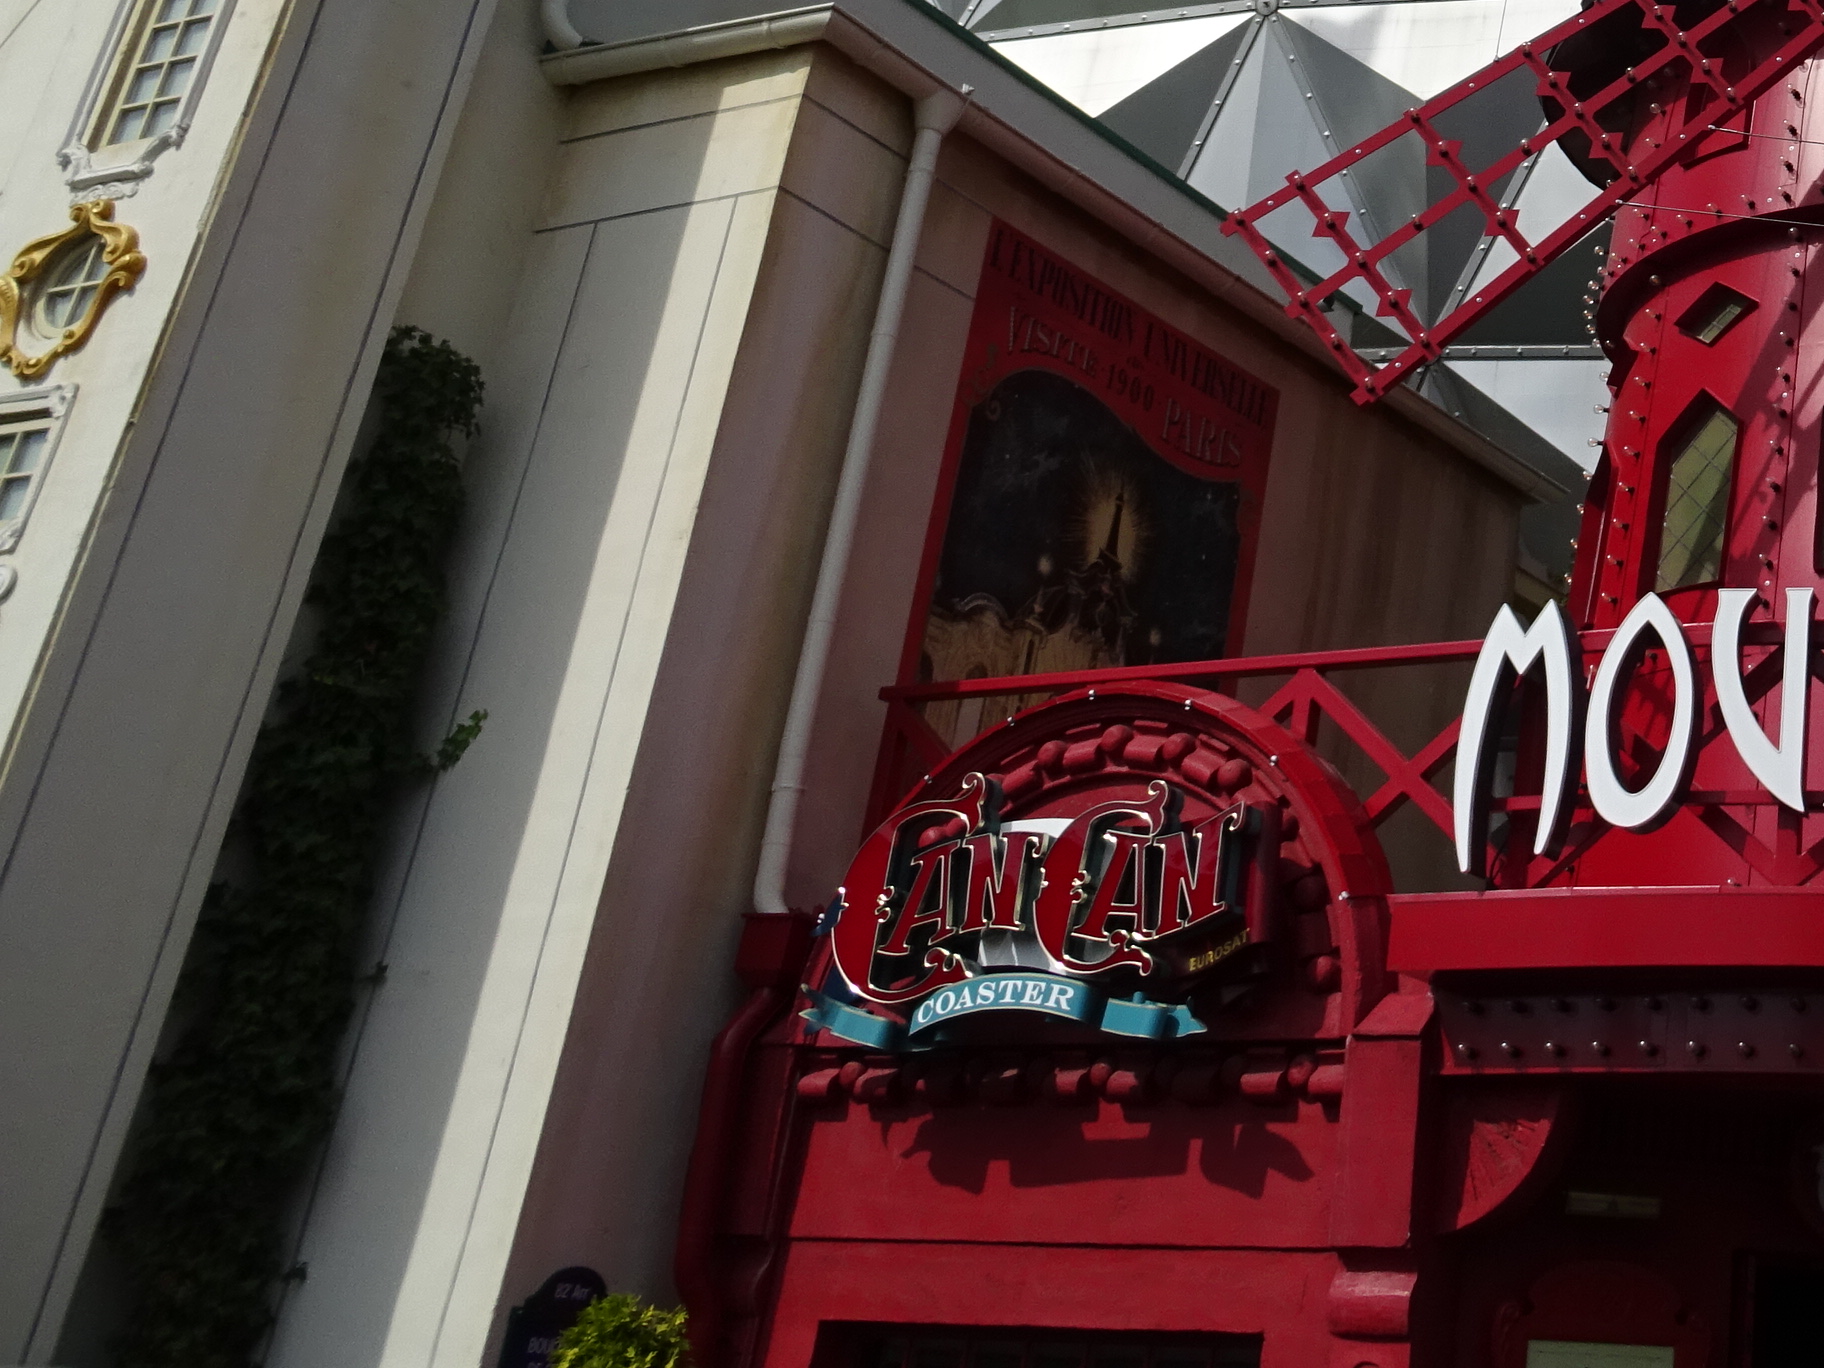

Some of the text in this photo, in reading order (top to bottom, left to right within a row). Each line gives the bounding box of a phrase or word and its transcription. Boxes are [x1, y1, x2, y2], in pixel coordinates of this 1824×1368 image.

[1006, 306, 1242, 468] VISITE 1900 PARIS
[830, 772, 1246, 1004] CAN CAN
[916, 979, 1075, 1025] COASTER
[1187, 927, 1250, 973] EUROSAT
